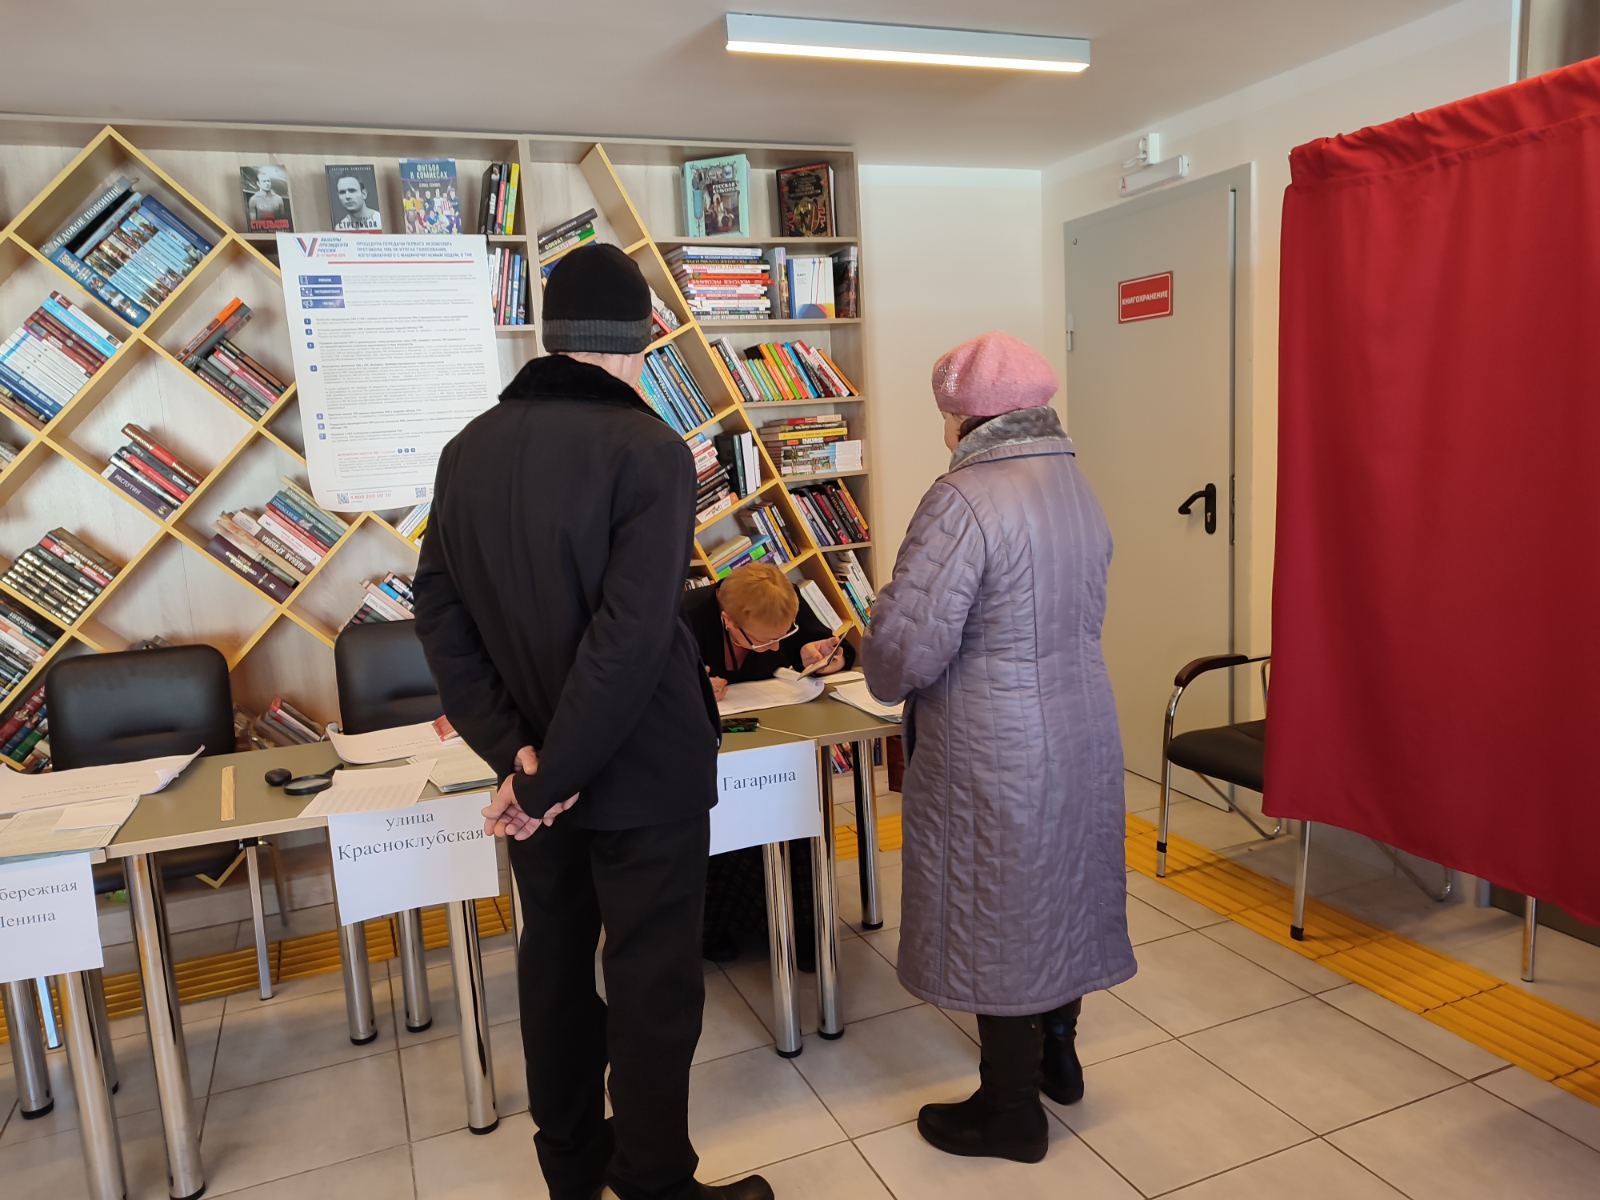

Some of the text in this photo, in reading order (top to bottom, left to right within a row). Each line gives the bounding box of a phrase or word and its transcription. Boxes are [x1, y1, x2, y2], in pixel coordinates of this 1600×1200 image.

[338, 220, 378, 229] СТРЕЛЬЦОВ
[1121, 289, 1168, 305] КНИГОХРАНЕНИЕ
[114, 474, 142, 496] РАСПУТИН
[723, 770, 797, 791] Гагарина
[385, 812, 434, 831] улица
[338, 828, 484, 862] Красноклубская
[0, 881, 77, 902] бережная
